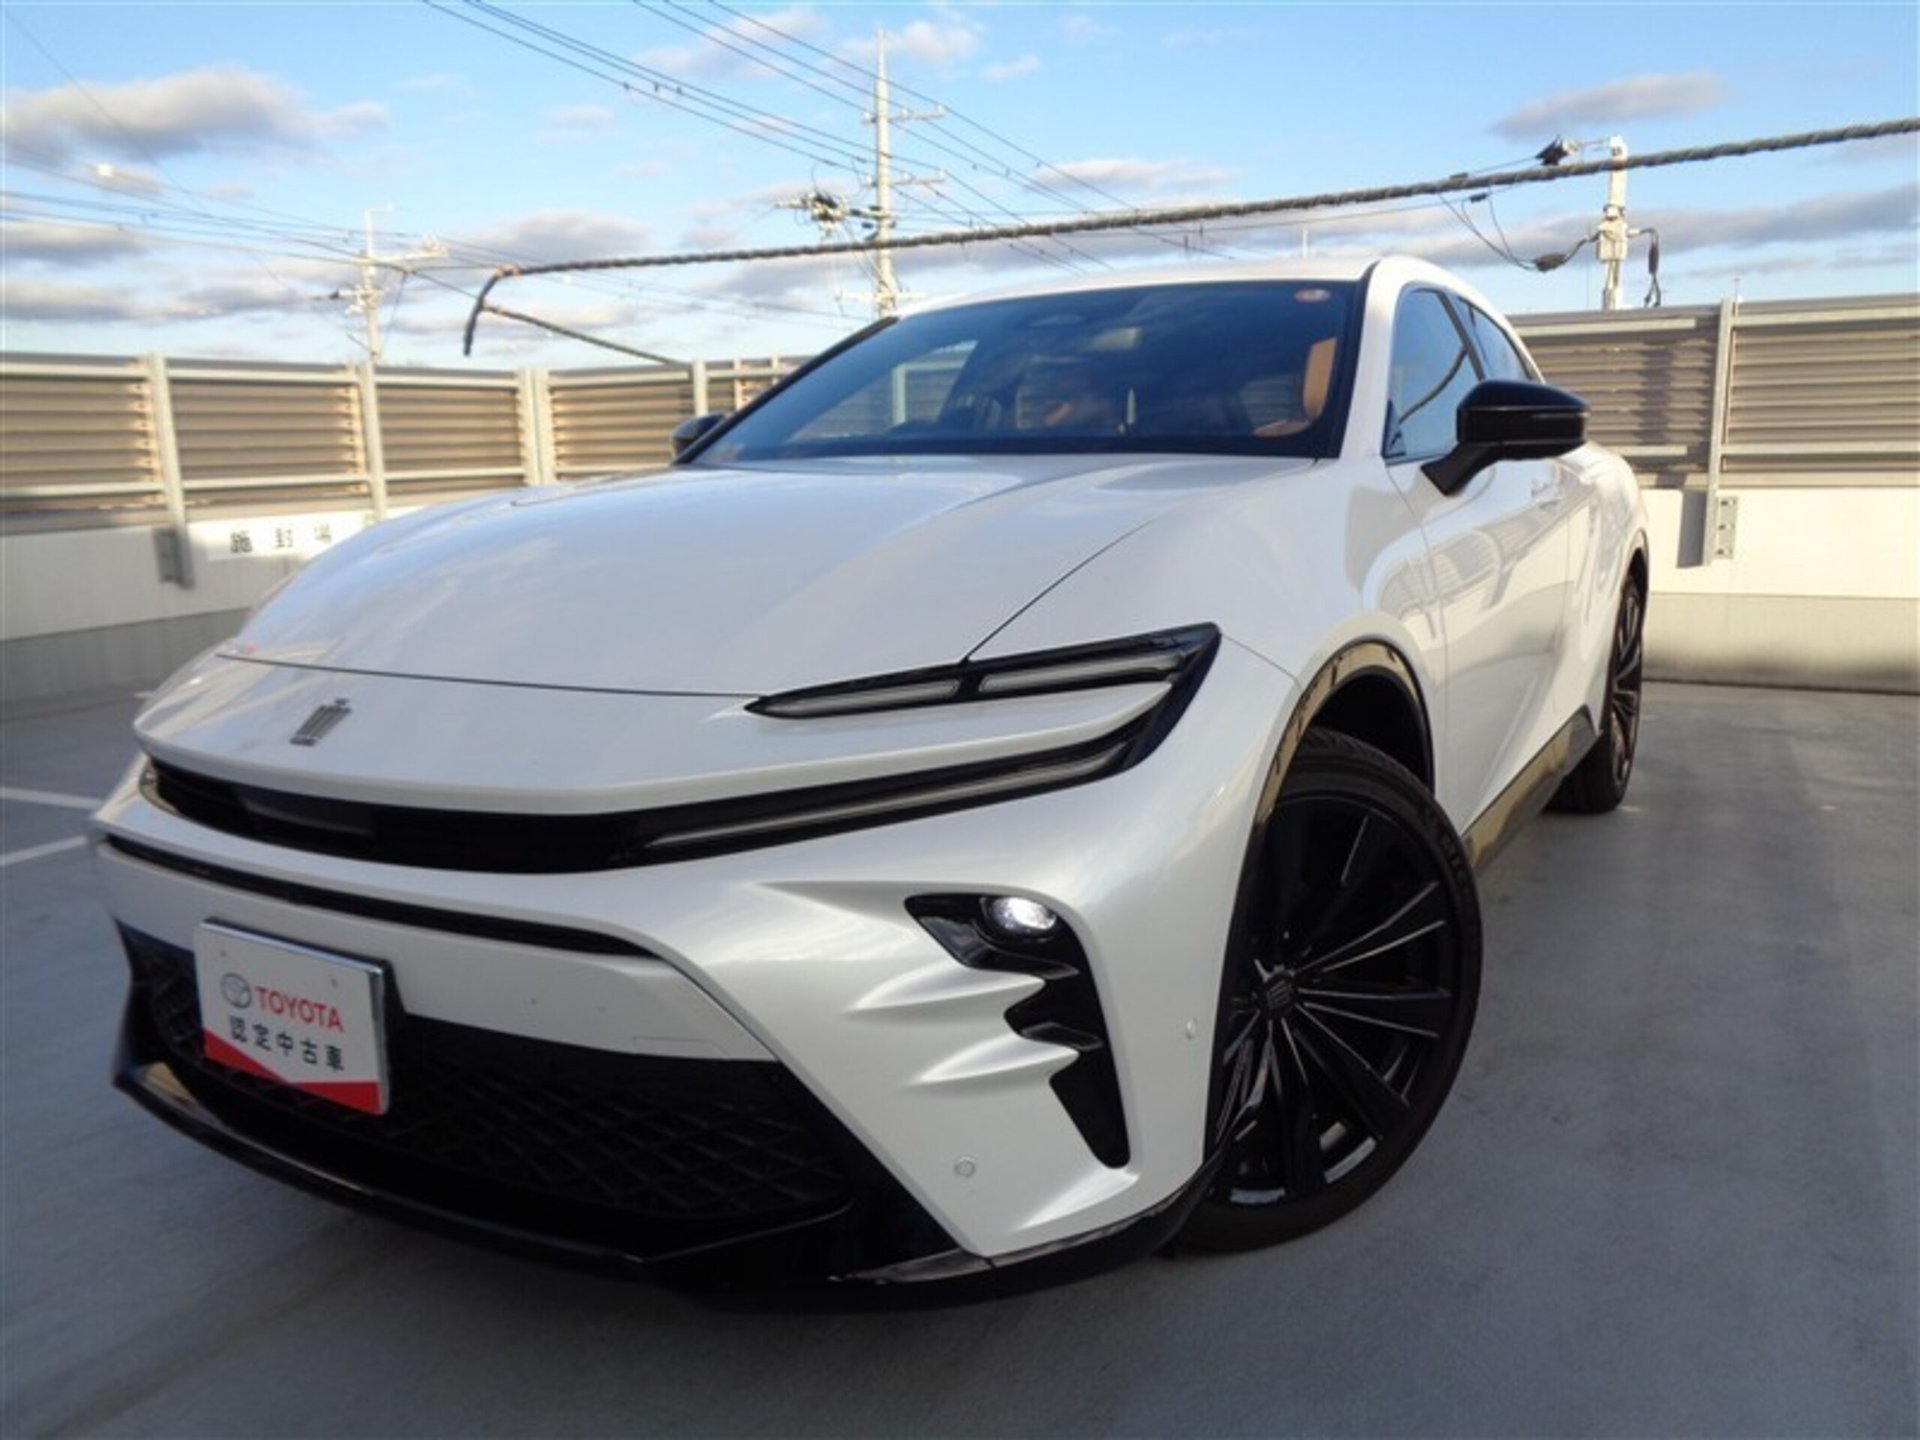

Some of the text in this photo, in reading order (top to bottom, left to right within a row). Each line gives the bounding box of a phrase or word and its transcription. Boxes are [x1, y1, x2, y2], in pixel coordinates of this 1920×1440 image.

[255, 986, 343, 1033] TOYOTA
[230, 1015, 343, 1072] 認定中古車
